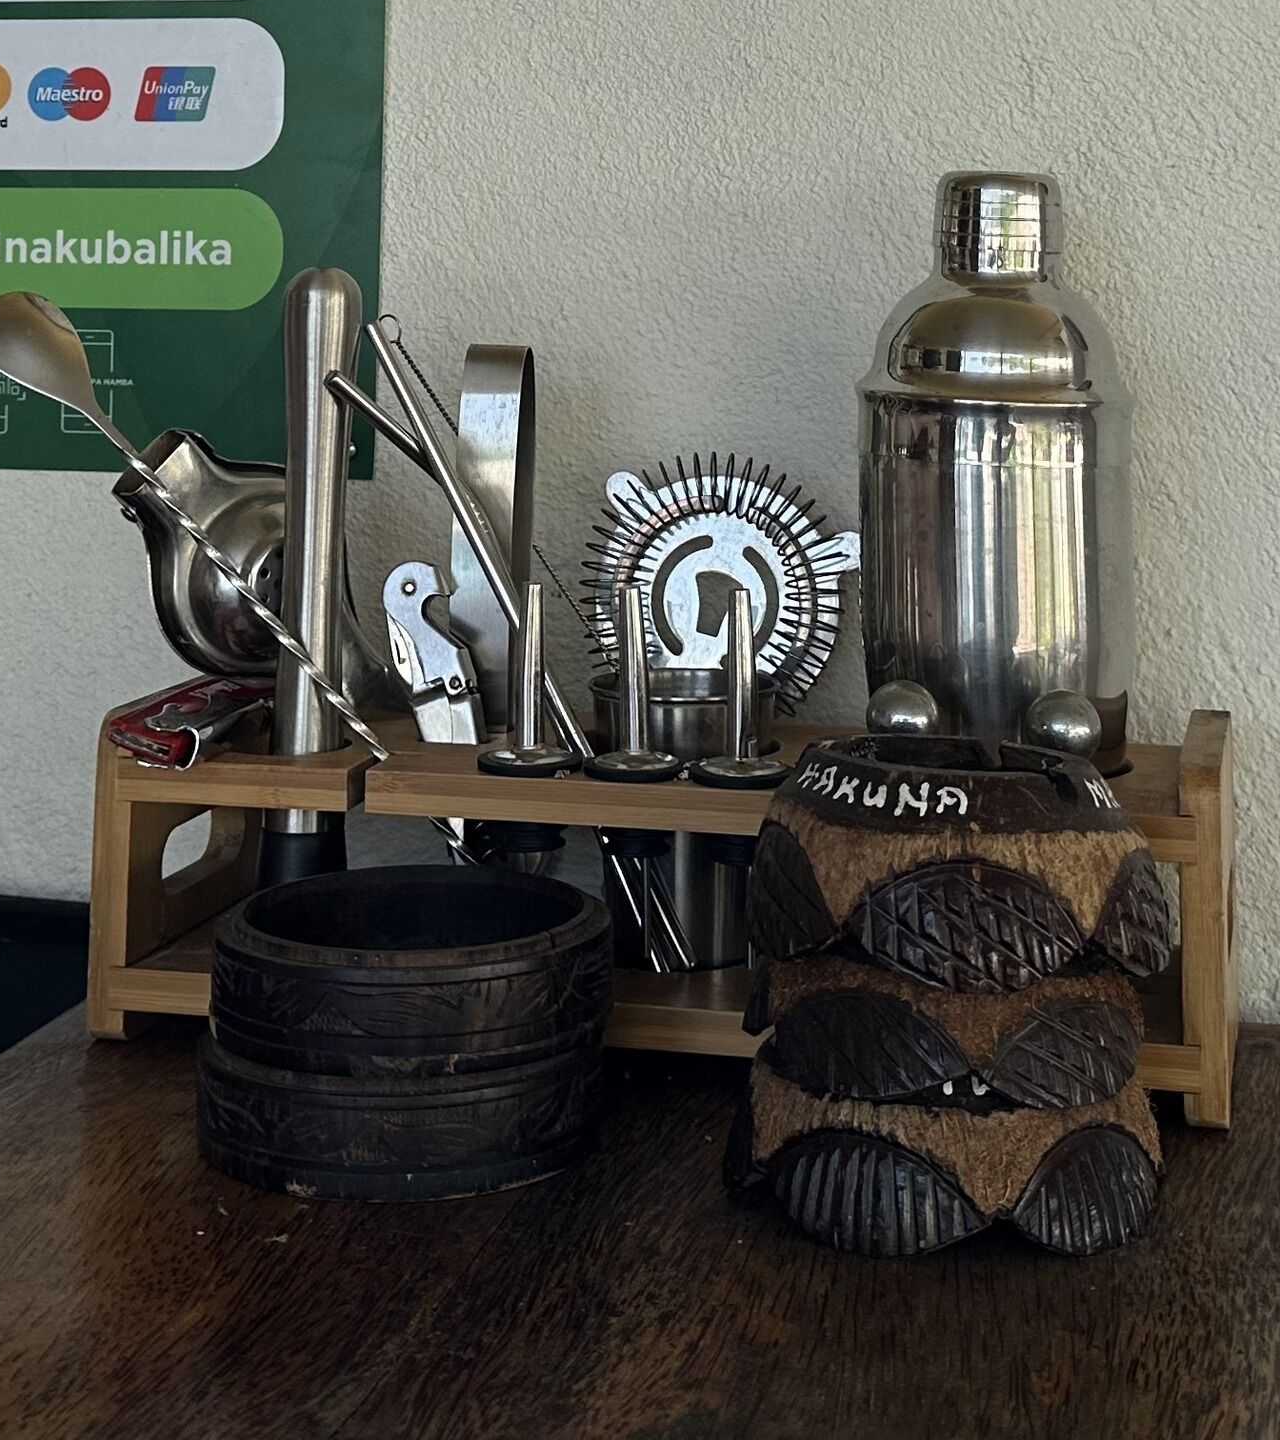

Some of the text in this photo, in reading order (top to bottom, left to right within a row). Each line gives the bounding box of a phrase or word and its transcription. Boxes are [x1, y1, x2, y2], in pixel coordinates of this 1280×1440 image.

[36, 86, 104, 103] Maestro
[143, 80, 210, 101] UnionPay
[167, 96, 204, 111] 银联
[797, 762, 969, 817] HAKUNA
